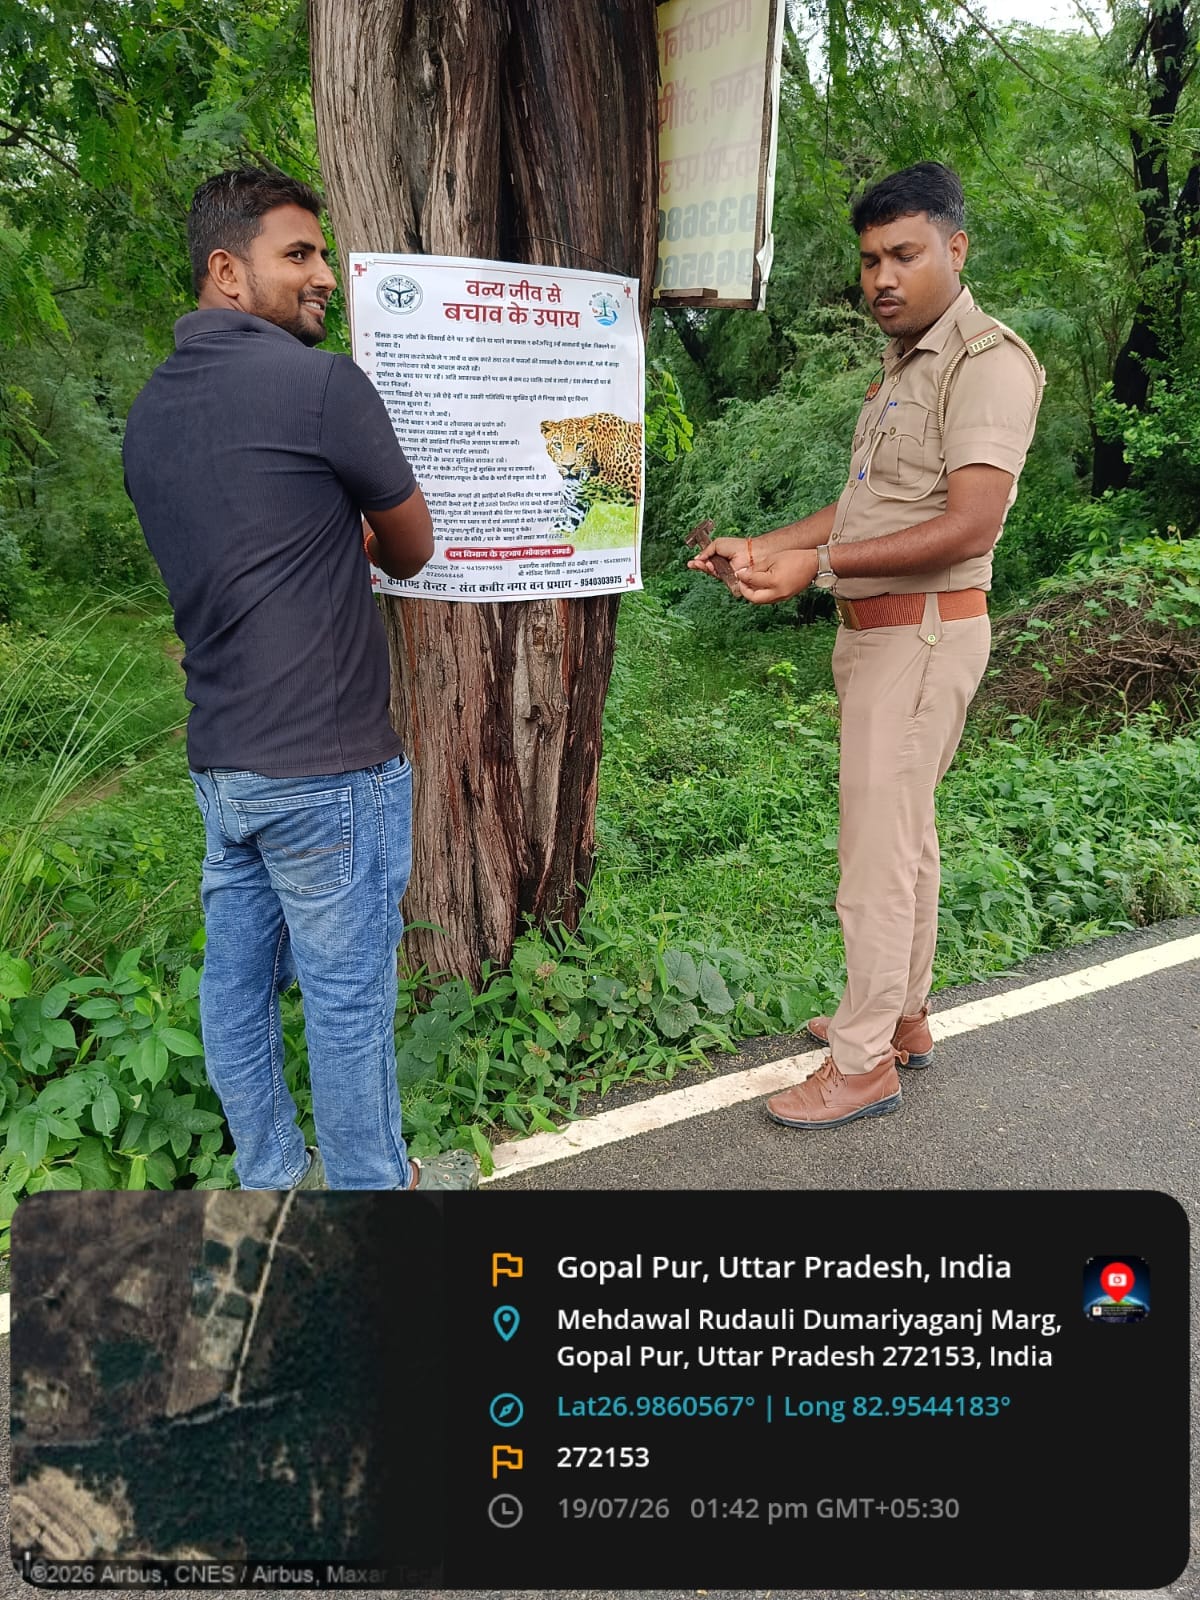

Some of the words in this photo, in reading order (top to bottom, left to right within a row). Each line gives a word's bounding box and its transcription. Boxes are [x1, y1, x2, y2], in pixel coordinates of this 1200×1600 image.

[466, 280, 505, 298] वन्य
[509, 280, 542, 301] जीव
[546, 283, 561, 303] से
[443, 303, 503, 323] बचाव
[507, 302, 529, 324] के
[533, 308, 580, 328] उपाय
[450, 550, 461, 559] वन
[463, 549, 487, 558] विभाग
[489, 549, 497, 558] के
[423, 579, 447, 592] सेन्टर
[459, 581, 476, 593] संत
[479, 580, 505, 592] कबीर
[507, 579, 527, 591] नगर
[529, 578, 543, 590] वन
[545, 577, 571, 590] प्रभाग
[580, 574, 622, 587] 9540303975
